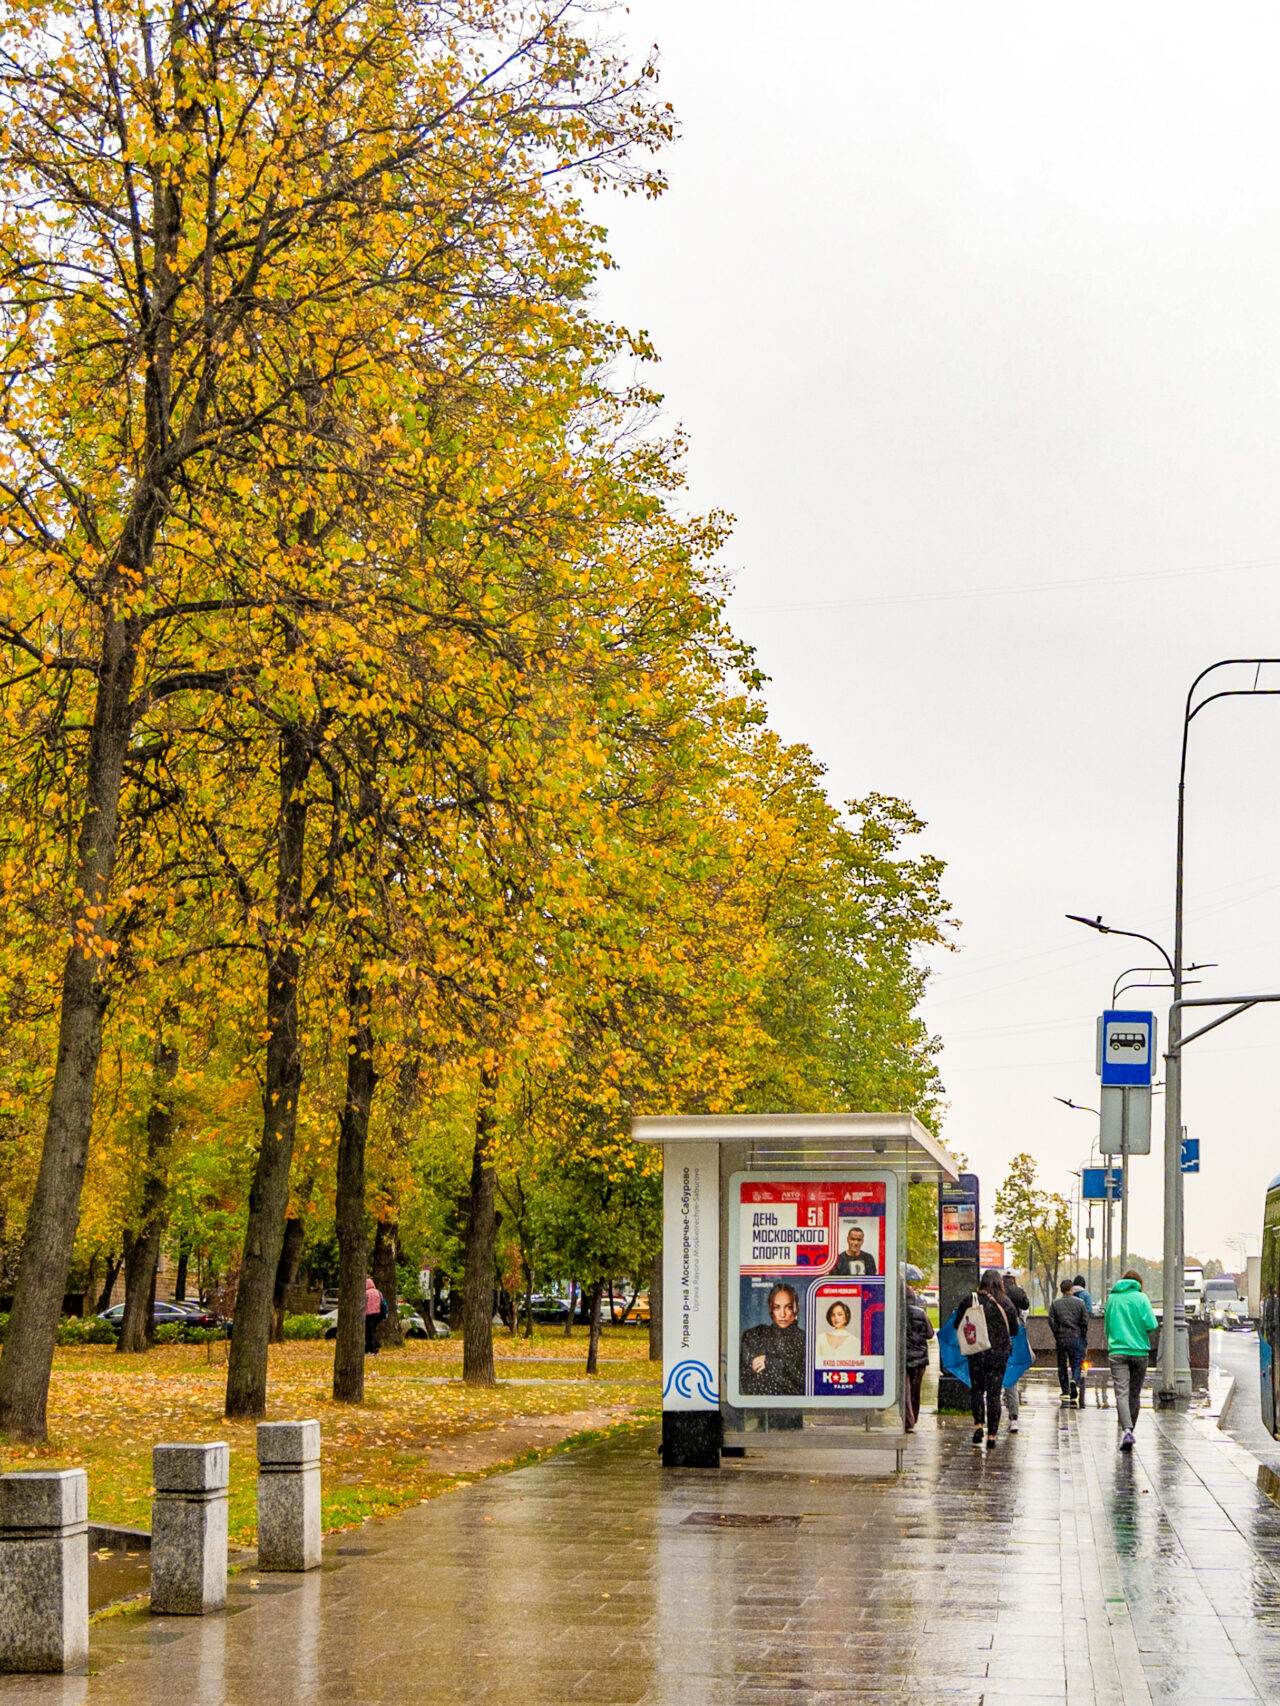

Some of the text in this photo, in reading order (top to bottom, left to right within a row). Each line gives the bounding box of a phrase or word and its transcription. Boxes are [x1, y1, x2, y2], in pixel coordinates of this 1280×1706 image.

[752, 1213, 778, 1227] ДЕНЬ
[807, 1206, 817, 1226] 5
[752, 1229, 825, 1243] МОСКОВСКОГО
[681, 1167, 692, 1349] Управа р-на Москворечье-Сабурово
[752, 1246, 791, 1259] СПОРТА
